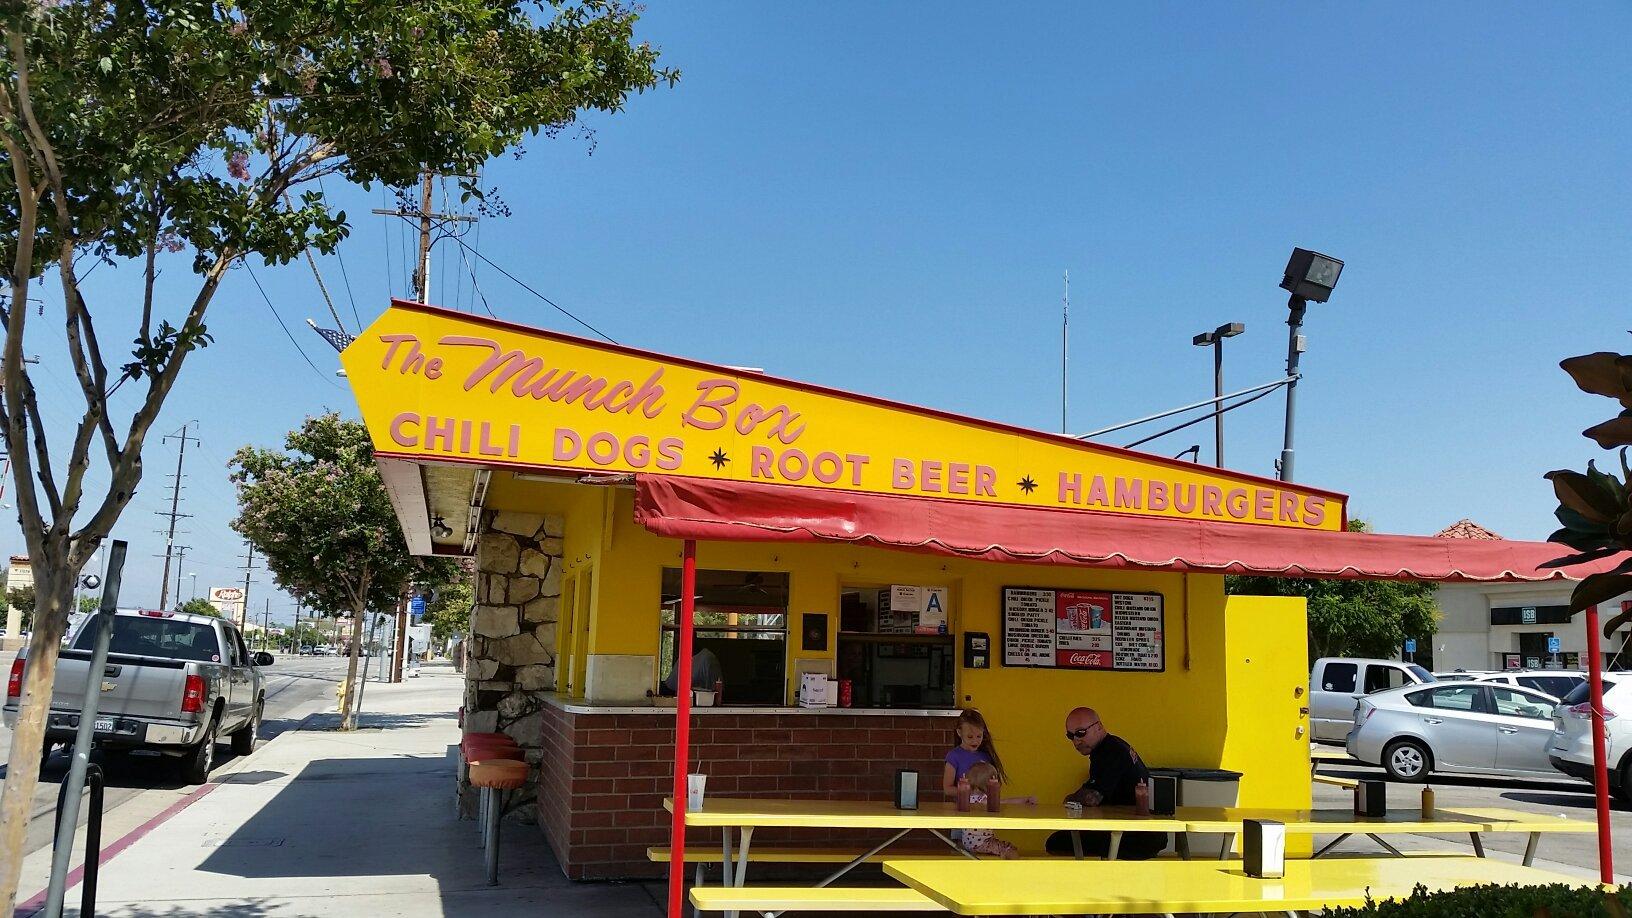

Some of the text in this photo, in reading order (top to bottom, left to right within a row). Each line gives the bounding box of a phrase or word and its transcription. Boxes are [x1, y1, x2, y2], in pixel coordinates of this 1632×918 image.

[379, 333, 807, 444] The Munch Box
[390, 412, 685, 470] CHILI DOGS
[750, 446, 998, 498] ROOT BEER
[1058, 471, 1327, 527] HAMBURGERS
[927, 593, 942, 612] A
[1523, 610, 1535, 618] ISB
[1528, 660, 1538, 668] ISB
[95, 722, 112, 731] 1502
